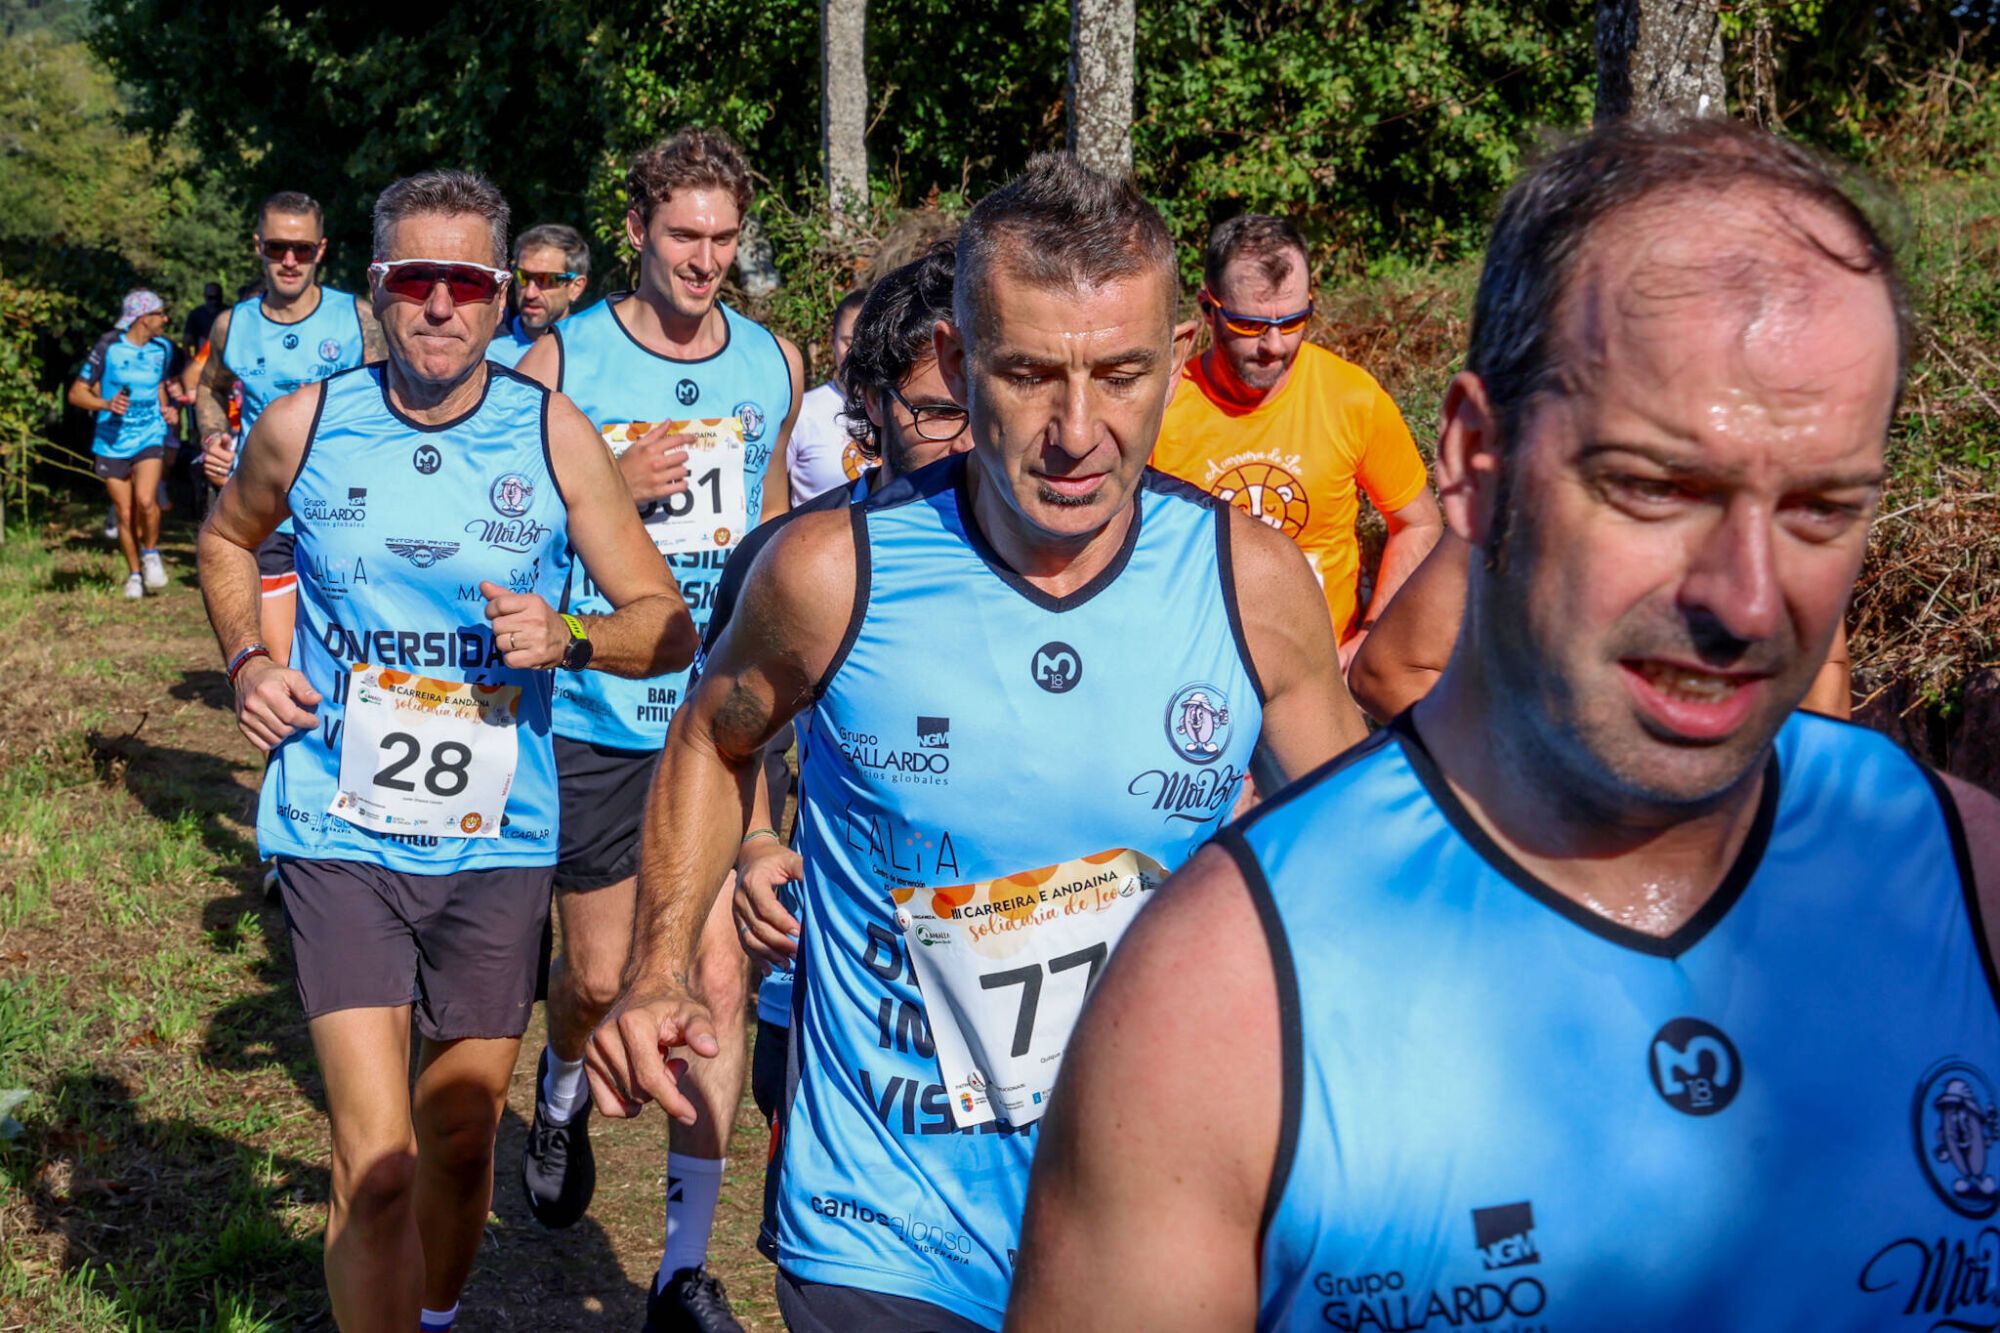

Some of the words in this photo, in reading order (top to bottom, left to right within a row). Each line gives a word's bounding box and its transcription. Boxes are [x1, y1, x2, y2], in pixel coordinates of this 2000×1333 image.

[304, 508, 366, 521] GALLARDO
[396, 685, 442, 702] CARREIRA
[647, 687, 677, 705] BAR
[840, 726, 878, 746] Grupo
[373, 732, 472, 797] 28
[840, 743, 949, 774] GALLARDO
[892, 773, 949, 785] globales
[964, 894, 1036, 919] CARREIRA
[1040, 890, 1047, 902] E
[969, 907, 1059, 942] solidaria
[1064, 893, 1087, 915] de
[1094, 887, 1119, 912] Leo
[980, 941, 1108, 1058] 77
[1314, 1271, 1404, 1298] Grupo
[1321, 1277, 1547, 1333] GALLARDO
